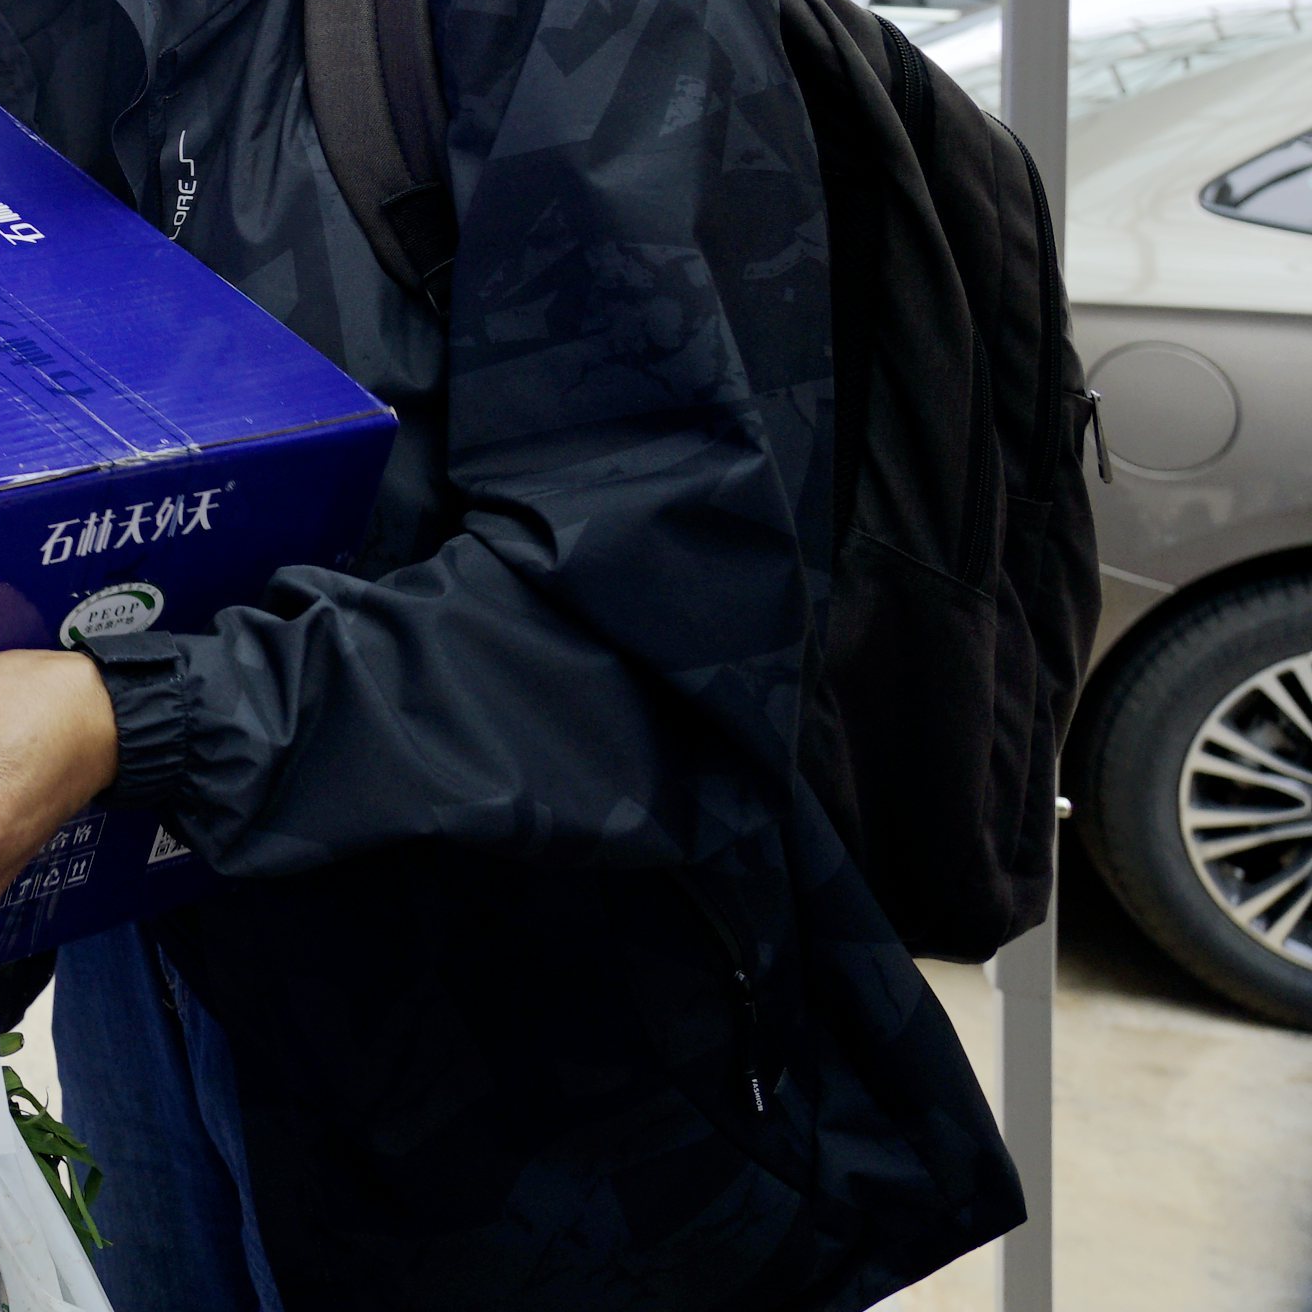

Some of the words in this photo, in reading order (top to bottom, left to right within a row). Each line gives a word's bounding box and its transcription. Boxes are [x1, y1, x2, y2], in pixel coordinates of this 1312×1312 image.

[40, 488, 222, 566] 石林天外天
[87, 602, 140, 624] PEOP
